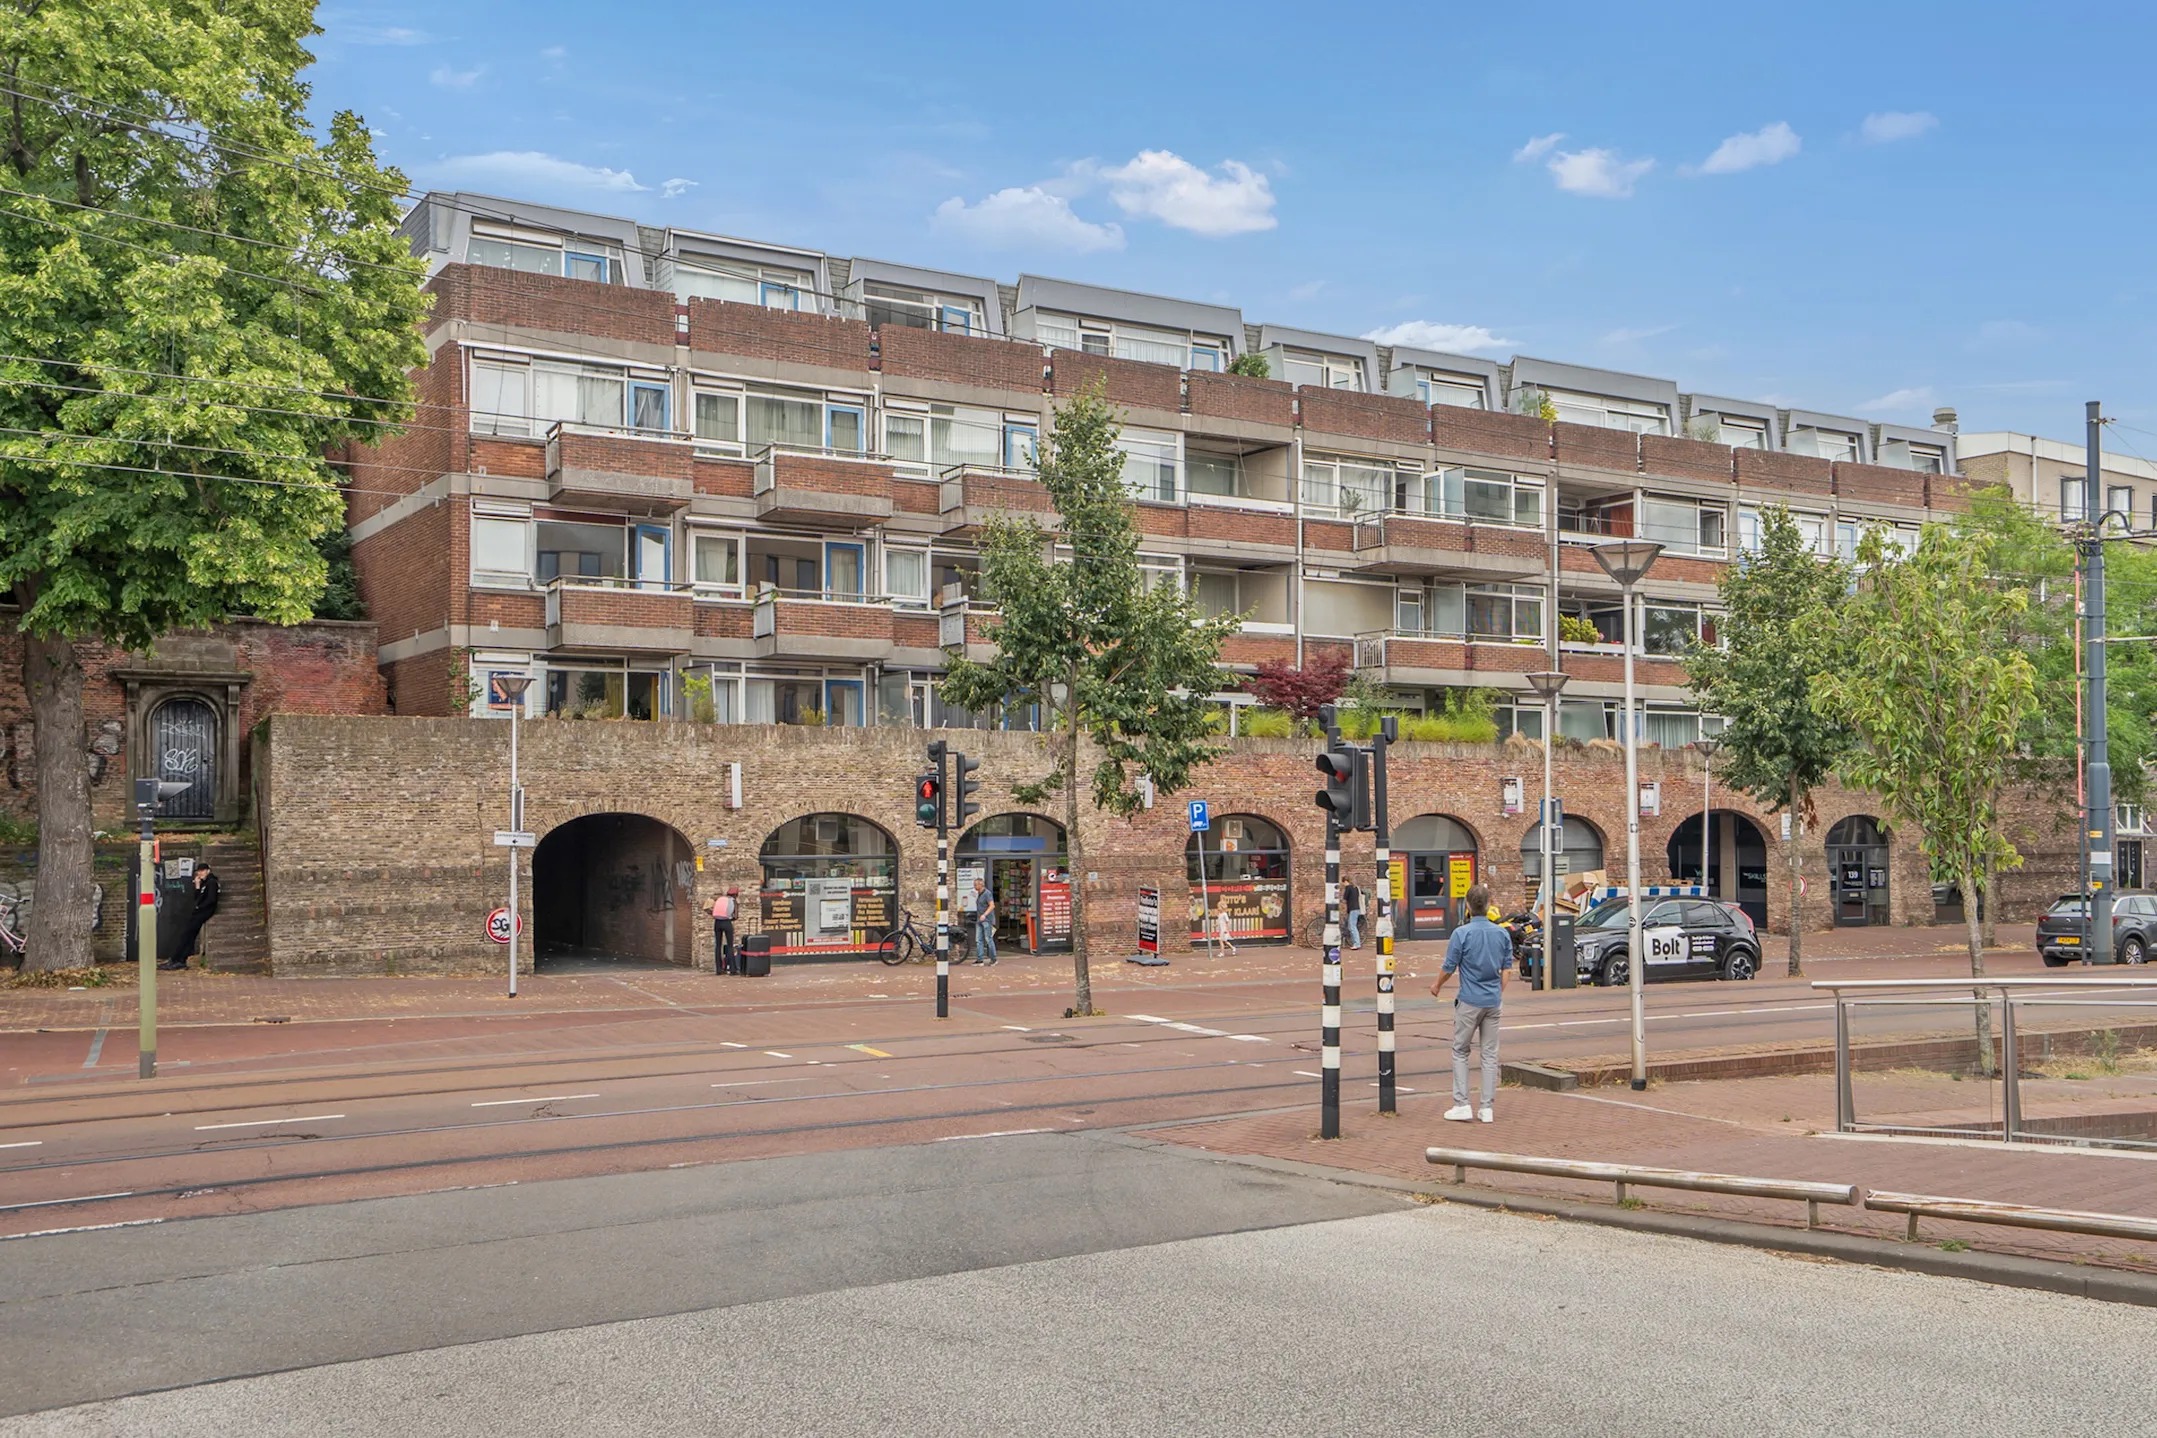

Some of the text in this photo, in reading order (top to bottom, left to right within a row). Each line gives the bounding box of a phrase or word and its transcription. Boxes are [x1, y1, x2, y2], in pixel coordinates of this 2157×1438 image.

[1192, 803, 1204, 819] P
[1847, 870, 1859, 879] 139
[1652, 938, 1680, 956] Bolt
